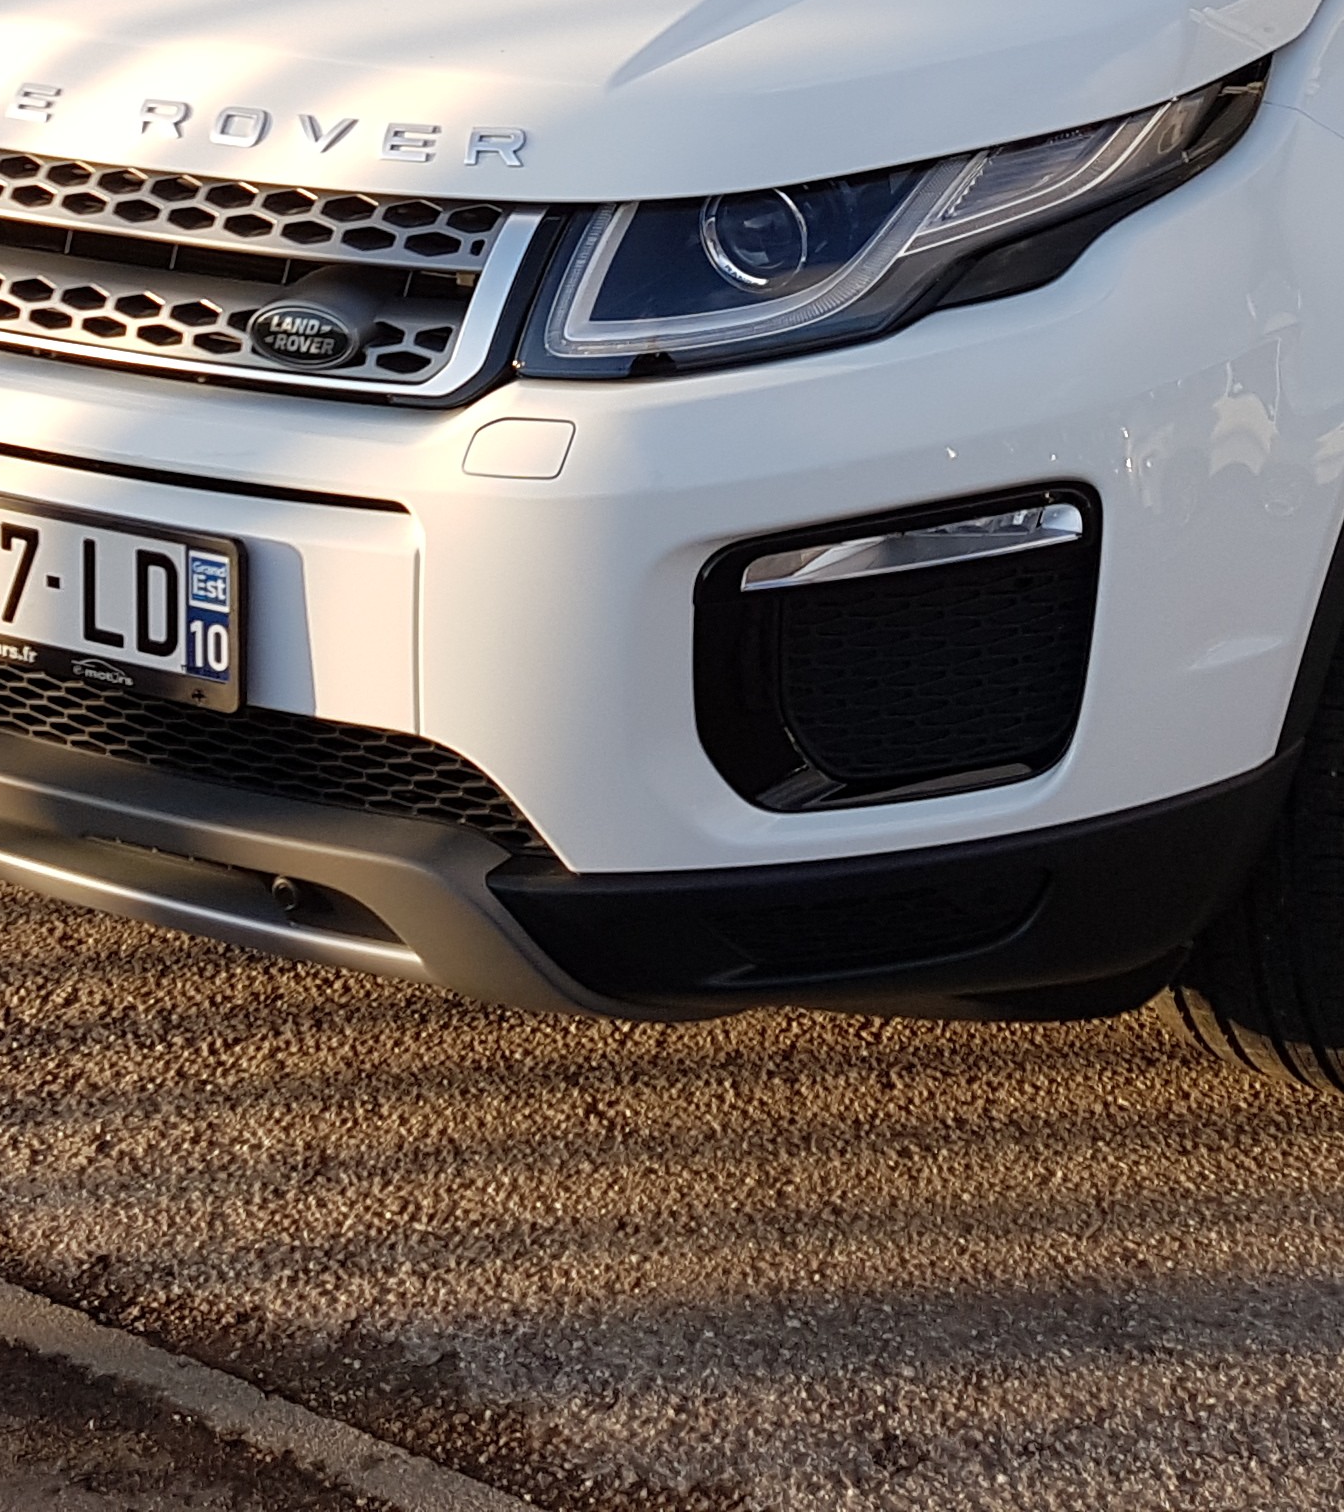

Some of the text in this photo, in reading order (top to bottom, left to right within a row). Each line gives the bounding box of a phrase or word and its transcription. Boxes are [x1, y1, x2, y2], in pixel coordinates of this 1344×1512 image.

[140, 97, 529, 167] ROVER
[270, 315, 321, 336] LAND
[274, 334, 336, 355] ROVER
[192, 561, 227, 578] Grand
[192, 574, 227, 601] Est
[190, 619, 230, 672] 10
